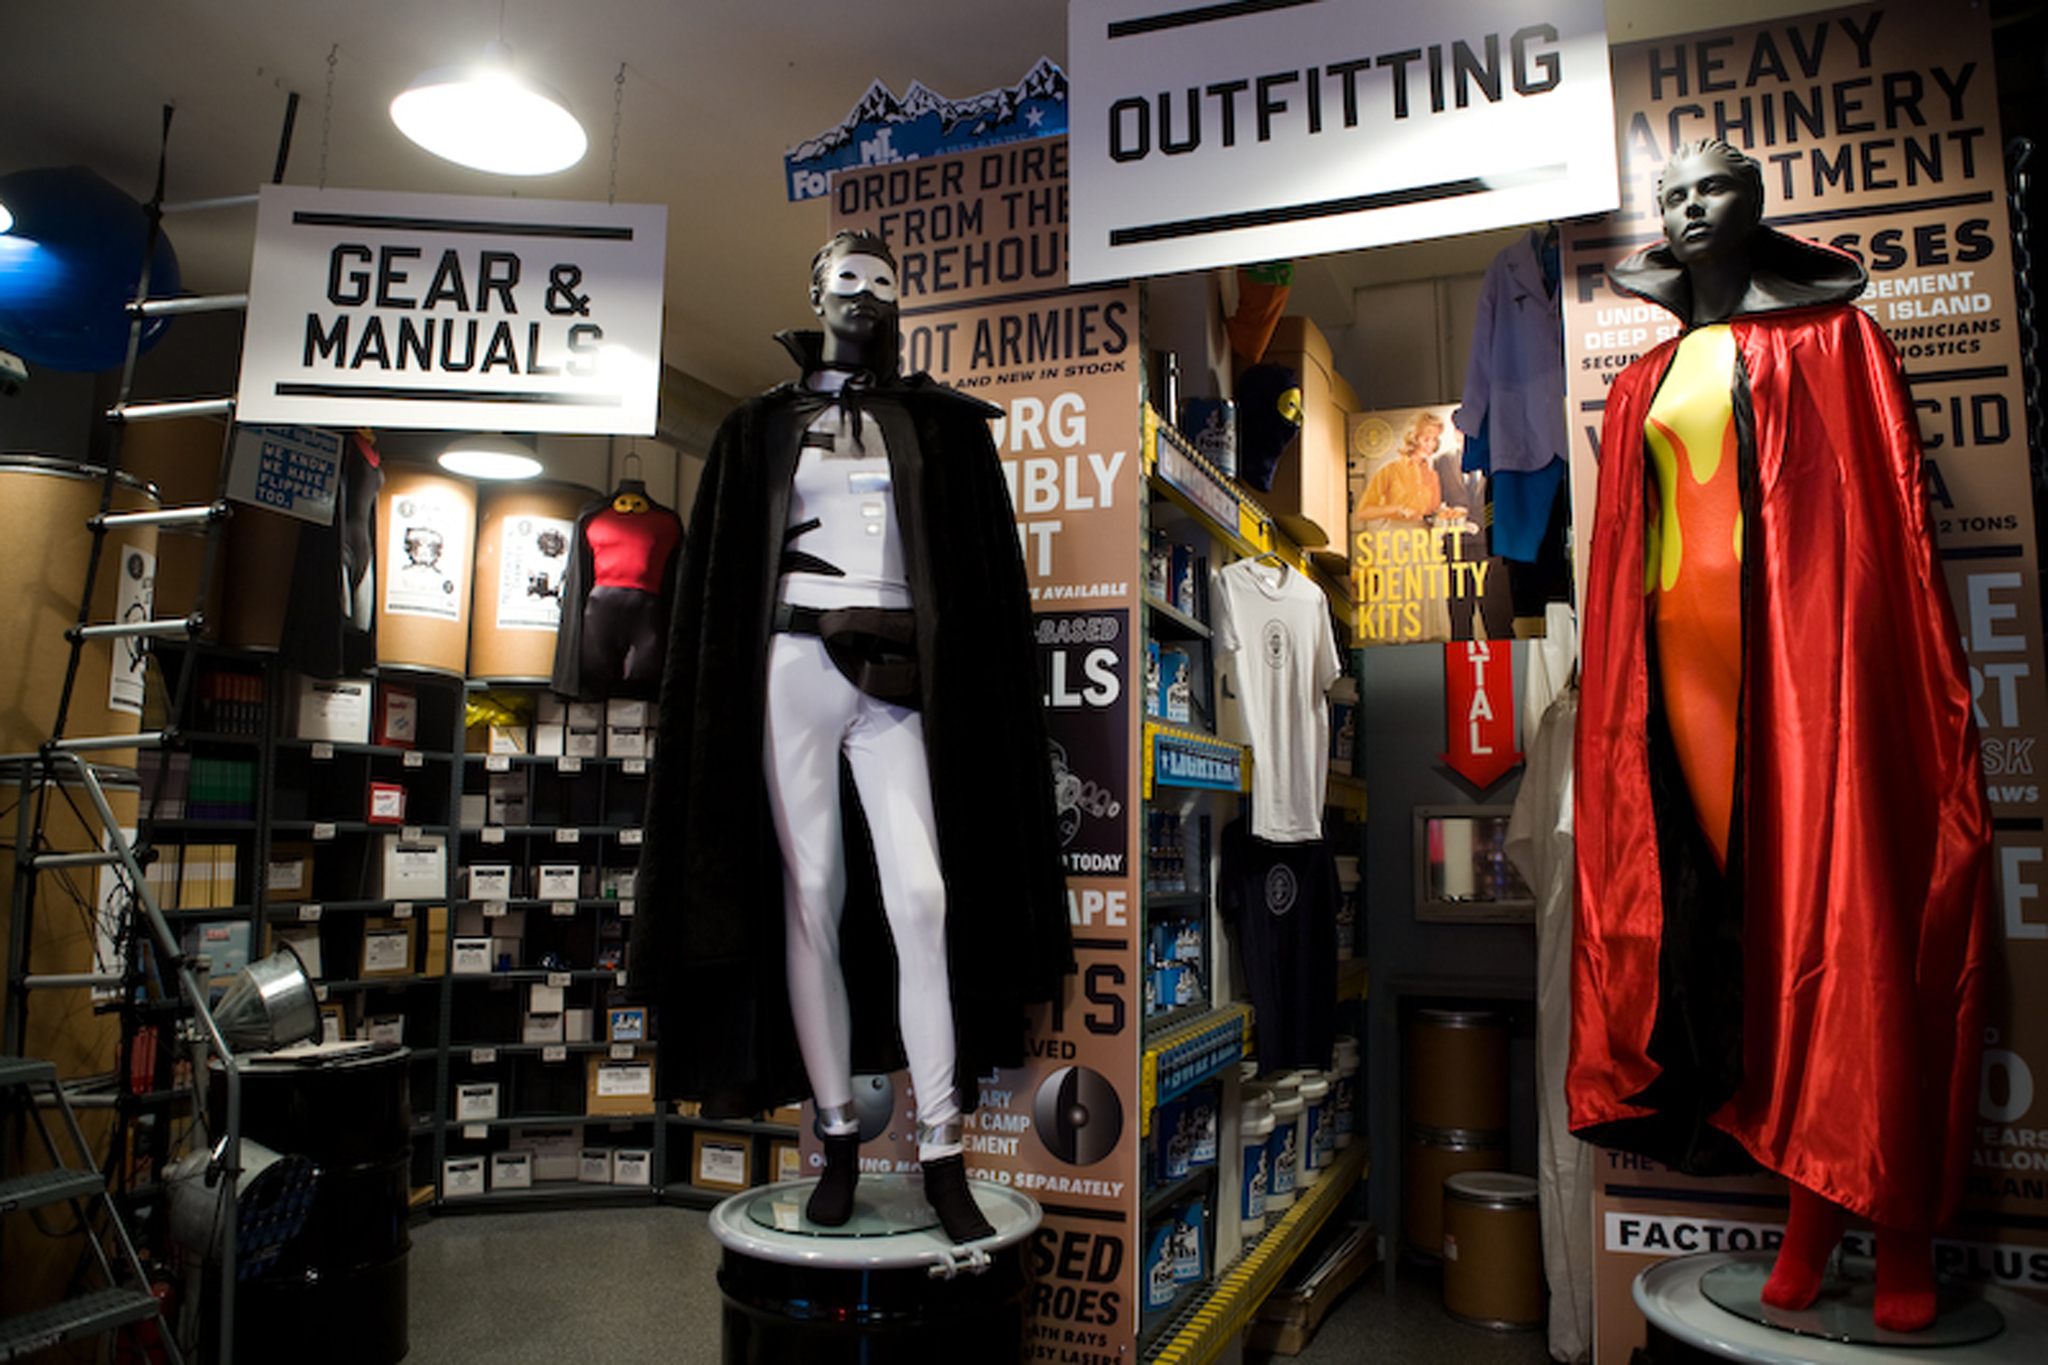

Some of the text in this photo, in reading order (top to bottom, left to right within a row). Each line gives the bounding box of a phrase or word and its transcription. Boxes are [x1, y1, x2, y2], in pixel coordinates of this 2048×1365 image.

[1648, 10, 1884, 101] HEAVY
[1109, 23, 1562, 163] OUTFITTING
[1627, 63, 1977, 167] ACHINERY
[838, 160, 965, 216] ORDER
[980, 141, 1068, 191] DIRE
[879, 199, 984, 249] FROM
[326, 243, 590, 316] GEAR &
[901, 231, 1068, 298] REHOU
[1857, 270, 1974, 301] SEMENT
[1888, 293, 1992, 321] ISLAND
[303, 313, 603, 377] MANUALS
[970, 300, 1128, 371] ARMIES
[1584, 328, 1647, 350] DEEP
[955, 375, 991, 390] AND
[995, 371, 1036, 386] NEW
[1039, 368, 1059, 380] IN
[1065, 360, 1127, 377] STOCK
[1914, 393, 2011, 449] CID
[1959, 515, 2018, 532] TONS
[1355, 527, 1467, 568] SECRET
[1042, 582, 1128, 600] AVAILABLE
[1357, 560, 1489, 604] IDENTITY
[1358, 602, 1422, 641] KITS
[1980, 738, 2036, 775] SK
[1986, 786, 2039, 804] AWS
[1072, 854, 1123, 872] TODAY
[1068, 889, 1127, 927] APE
[1023, 1038, 1077, 1060] VED
[977, 1089, 1013, 1110] ARY
[980, 1112, 1031, 1134] CAMP
[963, 1133, 1019, 1157] EMENT
[1607, 1151, 1653, 1171] THE
[1014, 1172, 1124, 1198] SEPARATELY
[1031, 1228, 1122, 1283] SED
[1619, 1219, 1785, 1252] FACTOR
[1935, 1242, 2048, 1282] PLUS
[1033, 1283, 1120, 1325] ROES
[1032, 1324, 1107, 1347] ATH RAYS
